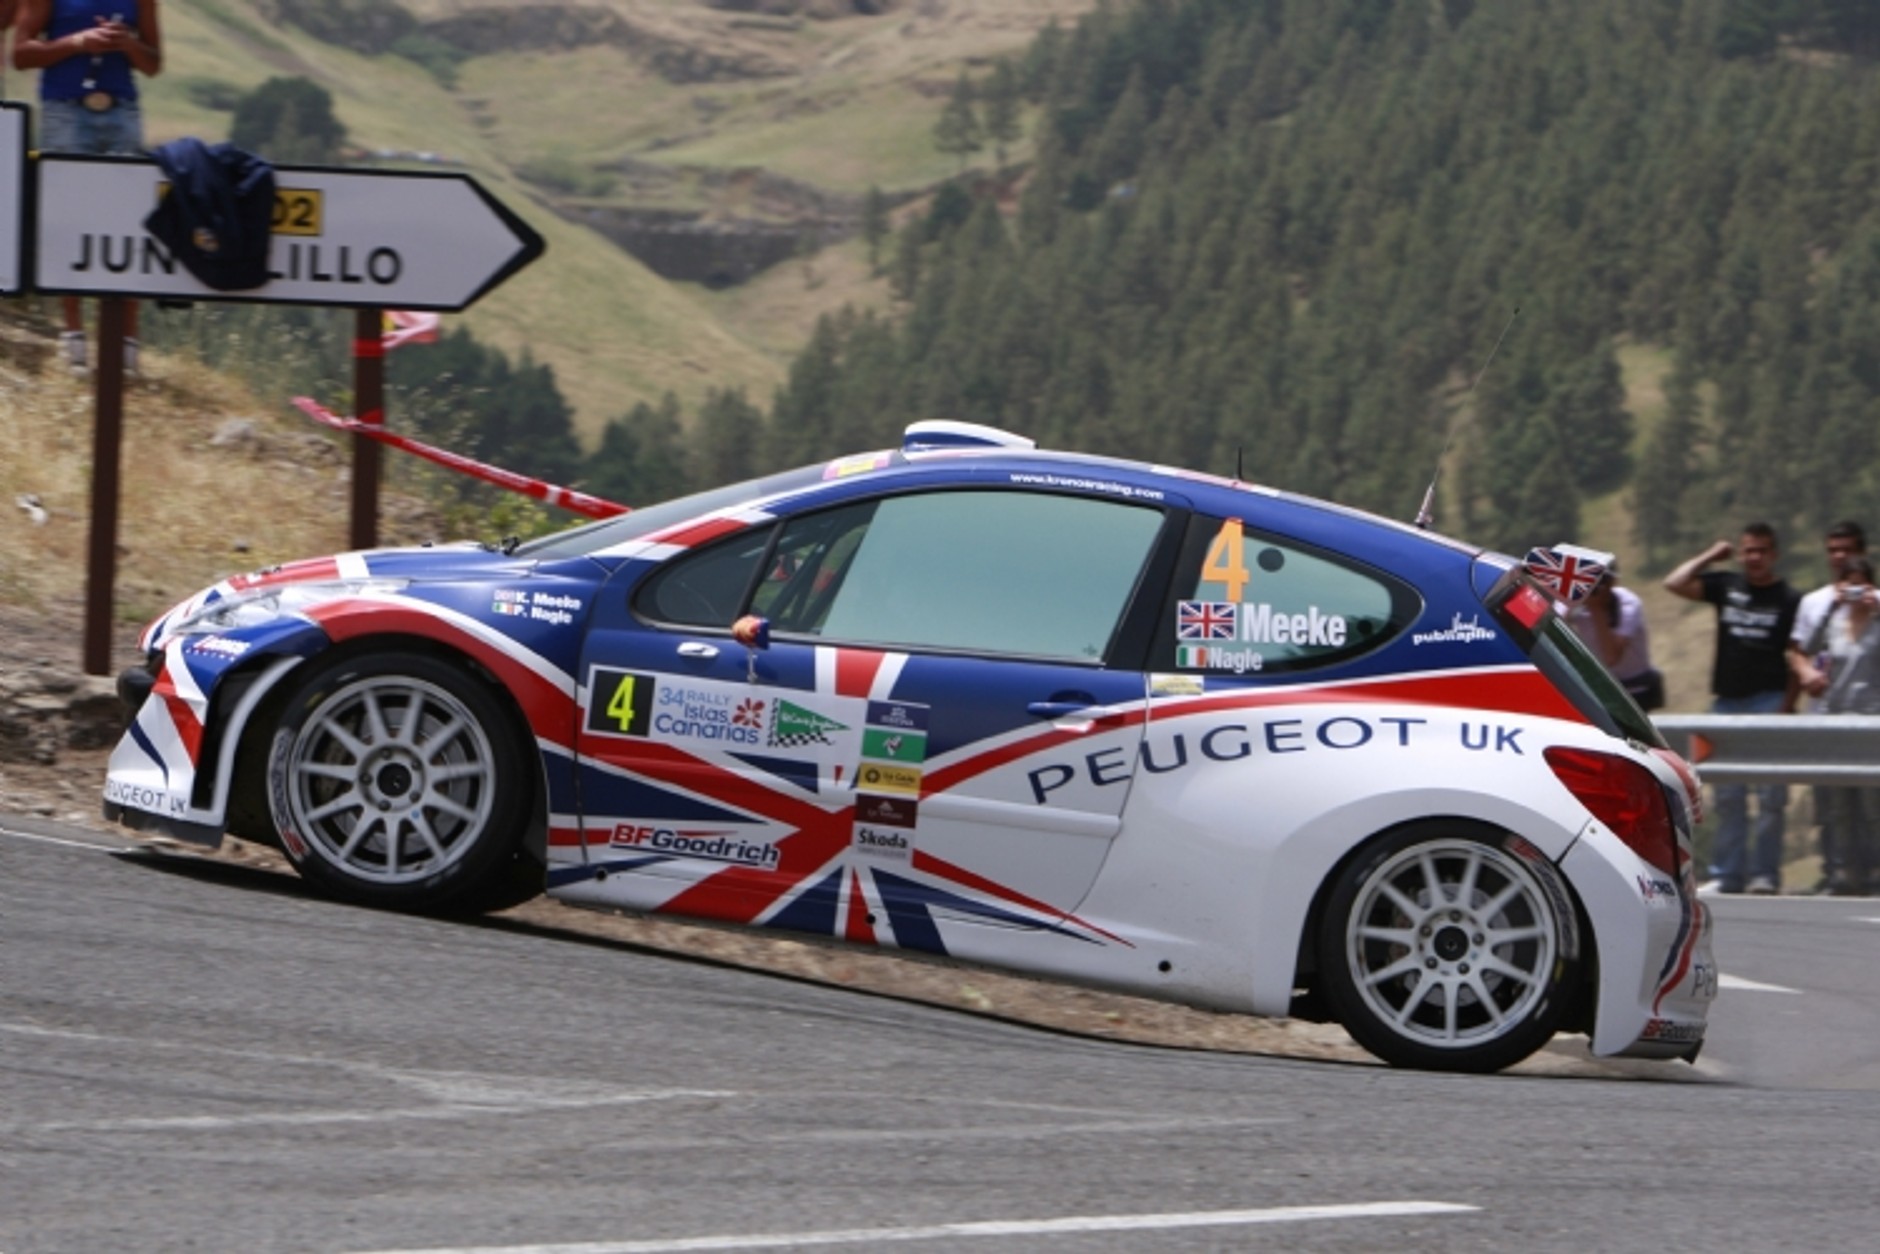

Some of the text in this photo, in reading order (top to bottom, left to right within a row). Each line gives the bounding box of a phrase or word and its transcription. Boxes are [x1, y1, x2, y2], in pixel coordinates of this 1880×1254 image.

[70, 234, 402, 286] JUNILLO
[1201, 517, 1249, 603] 4
[531, 606, 573, 624] Nagle
[534, 592, 581, 610] Meeke
[1243, 602, 1347, 646] Meeke
[1208, 647, 1263, 674] Nagle
[606, 673, 635, 731] 4
[658, 686, 732, 706] 34 RALLY
[684, 703, 729, 724] Islas
[655, 714, 760, 745] Canarias
[1028, 716, 1525, 804] PEUGEOT UK
[612, 824, 779, 864] BFGoodrich
